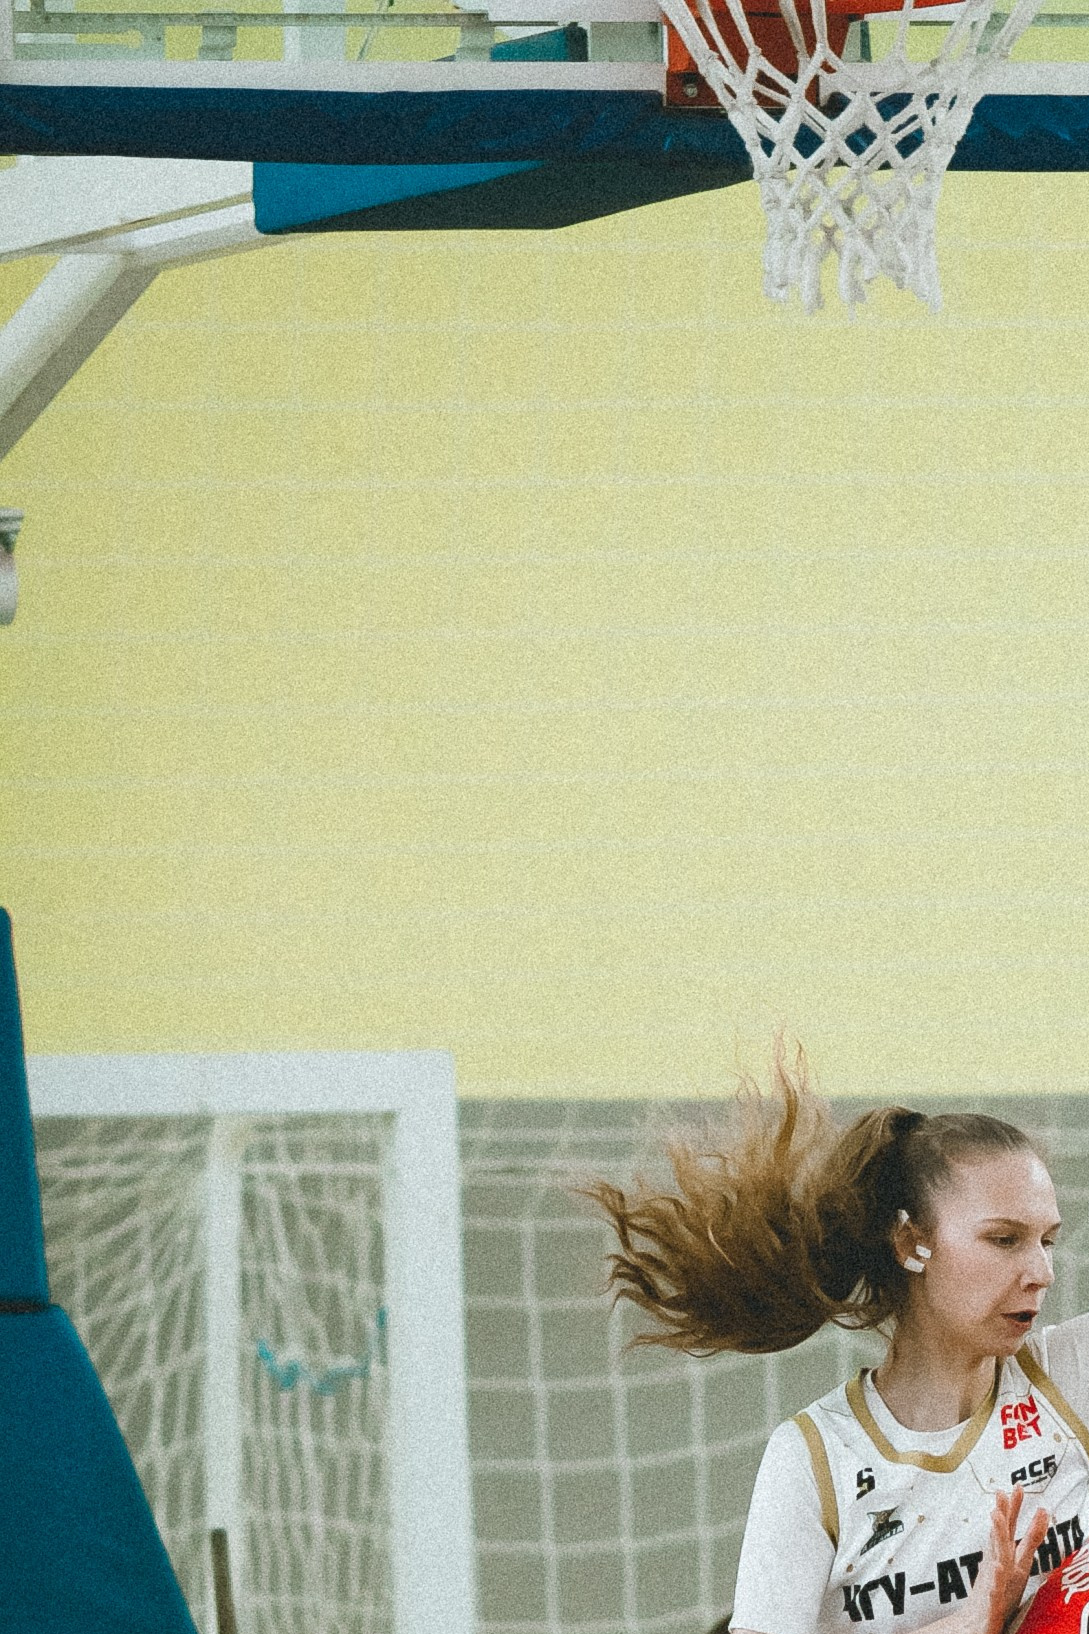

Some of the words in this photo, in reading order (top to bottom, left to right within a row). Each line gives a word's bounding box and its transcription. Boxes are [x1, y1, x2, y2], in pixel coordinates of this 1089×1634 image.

[1000, 1394, 1038, 1425] FIN
[1002, 1414, 1042, 1450] BET
[842, 1514, 1085, 1623] КГУ-АТНТА
